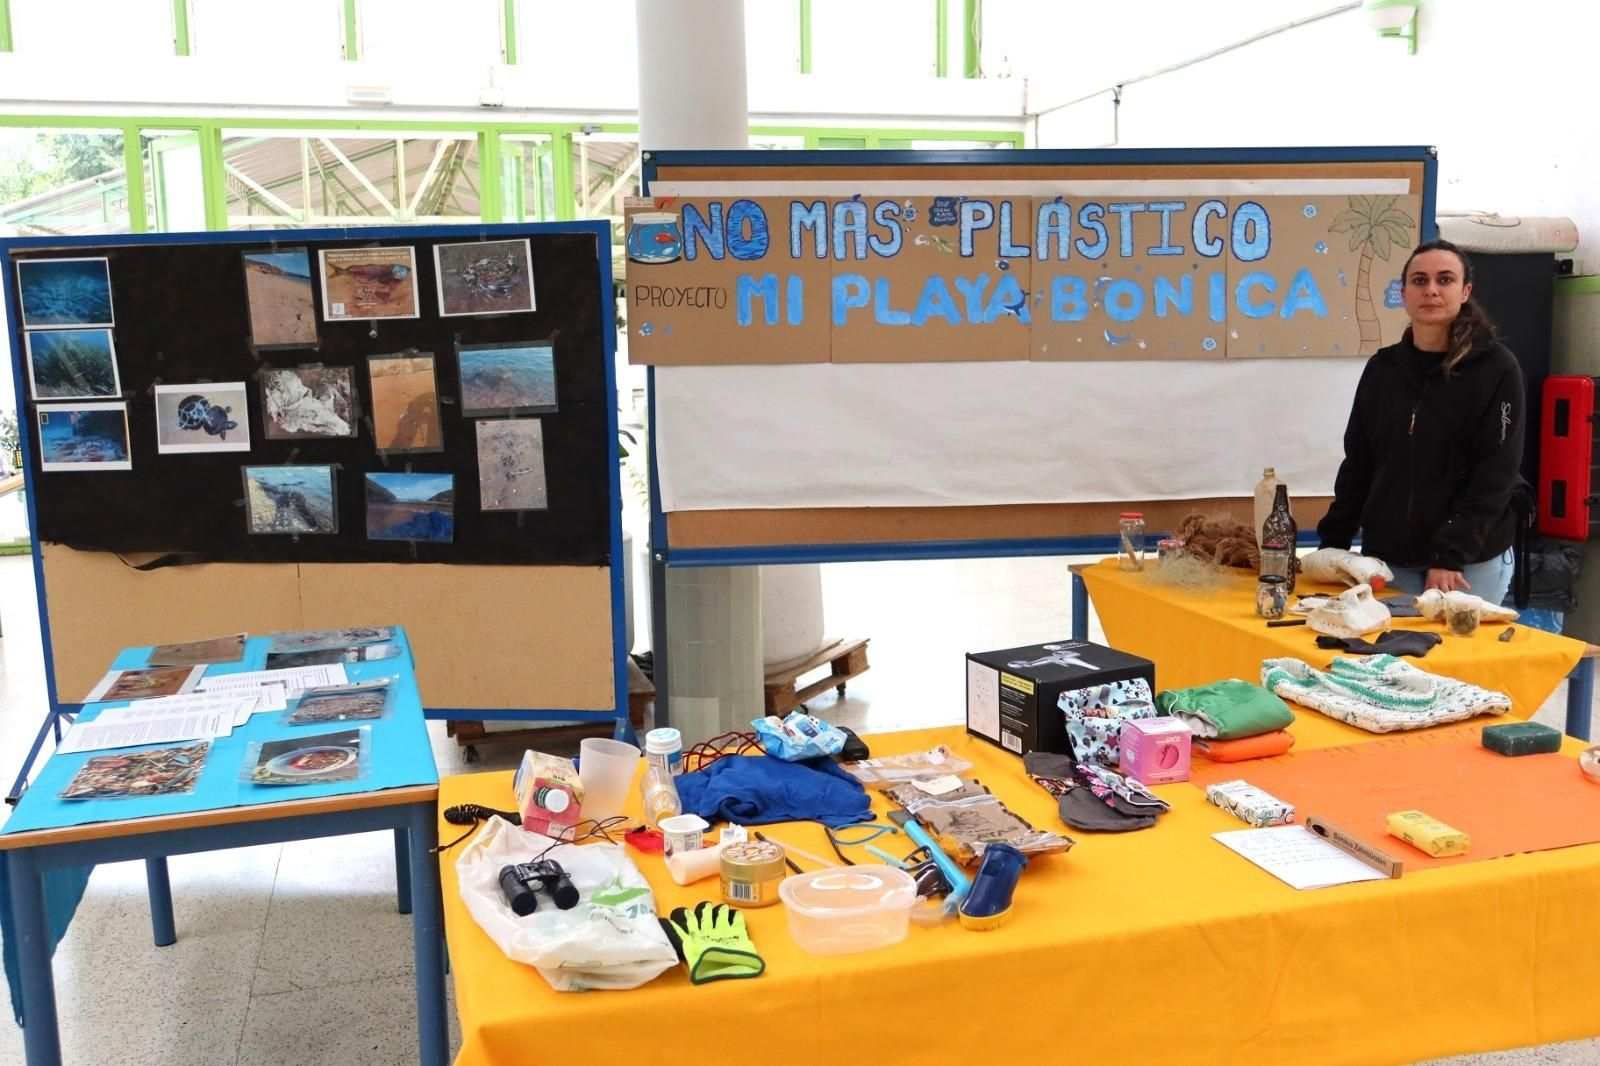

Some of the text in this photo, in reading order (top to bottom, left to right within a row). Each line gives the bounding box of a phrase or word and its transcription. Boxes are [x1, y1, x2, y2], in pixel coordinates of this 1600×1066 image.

[682, 194, 1271, 262] NO MÁS PLÁSTICO
[635, 285, 727, 310] PROYECTO
[736, 273, 804, 326] MI
[832, 273, 1032, 326] PLAYA
[1051, 268, 1328, 323] BONICA
[1333, 832, 1354, 849] Bambus
